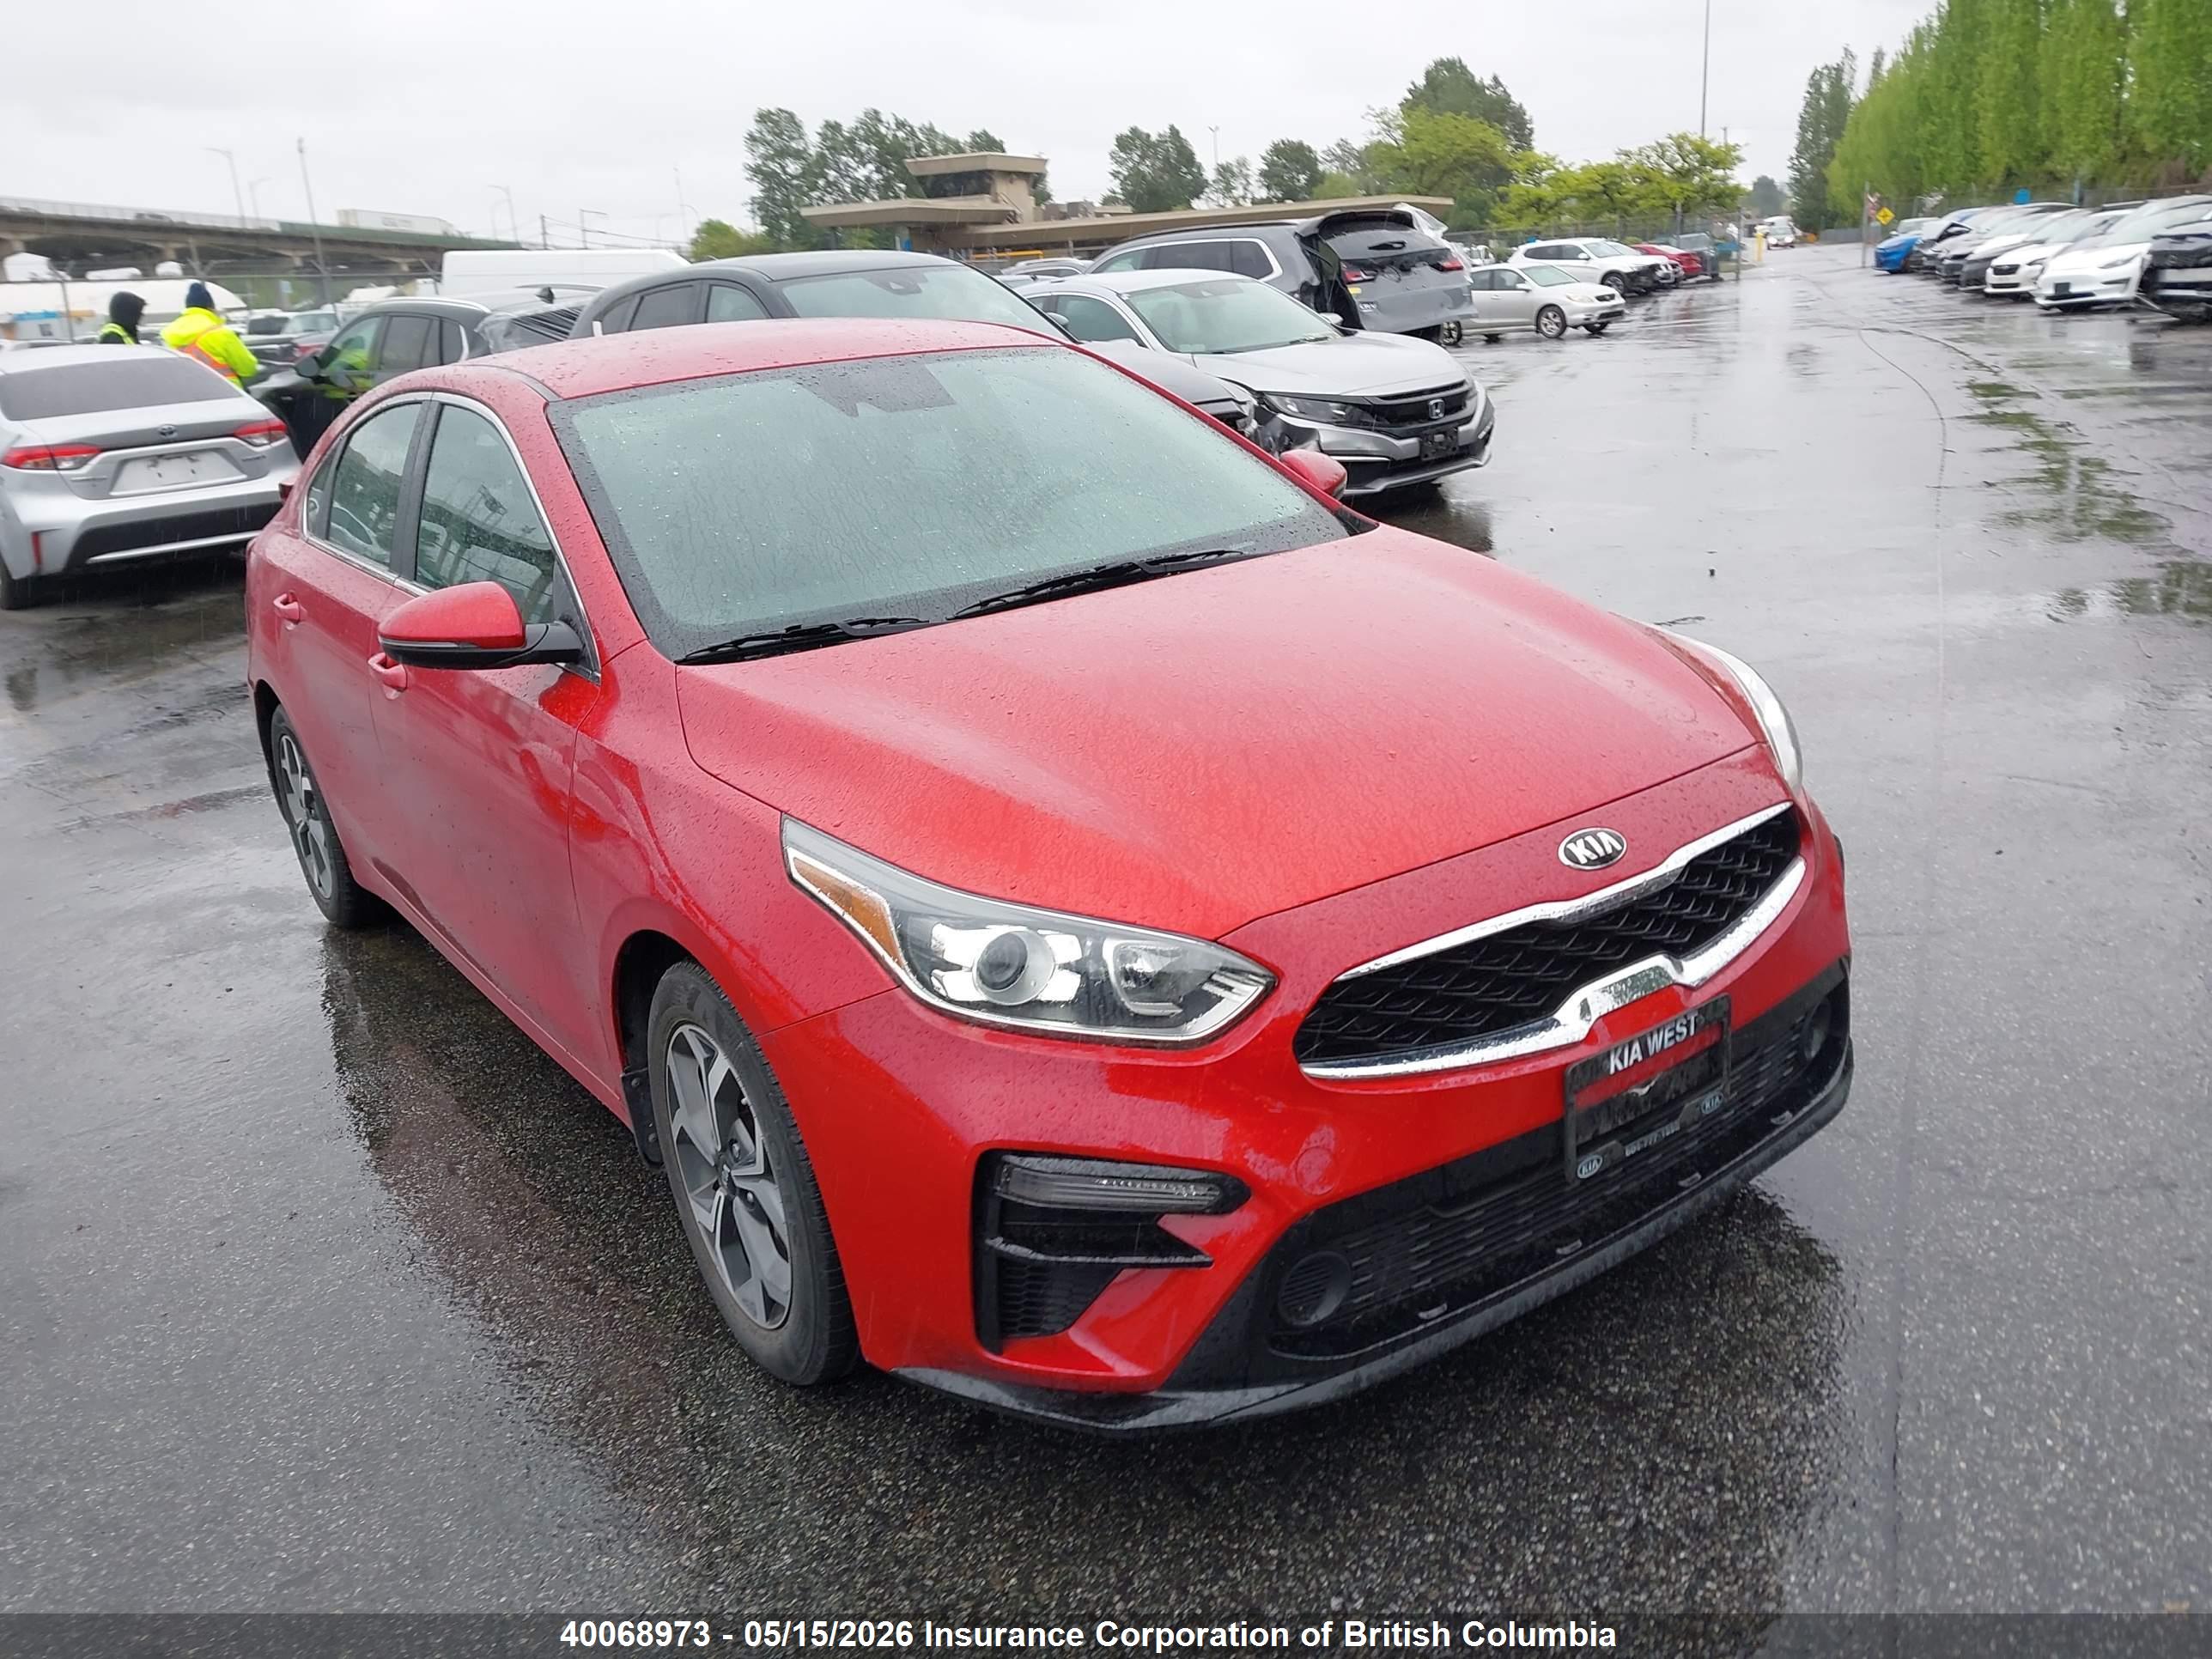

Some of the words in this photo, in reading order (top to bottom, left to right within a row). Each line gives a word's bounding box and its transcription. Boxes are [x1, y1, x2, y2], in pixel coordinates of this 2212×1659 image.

[1565, 831, 1623, 865] KIA
[1609, 1039, 1644, 1075] KIA
[1646, 1012, 1698, 1057] WEST
